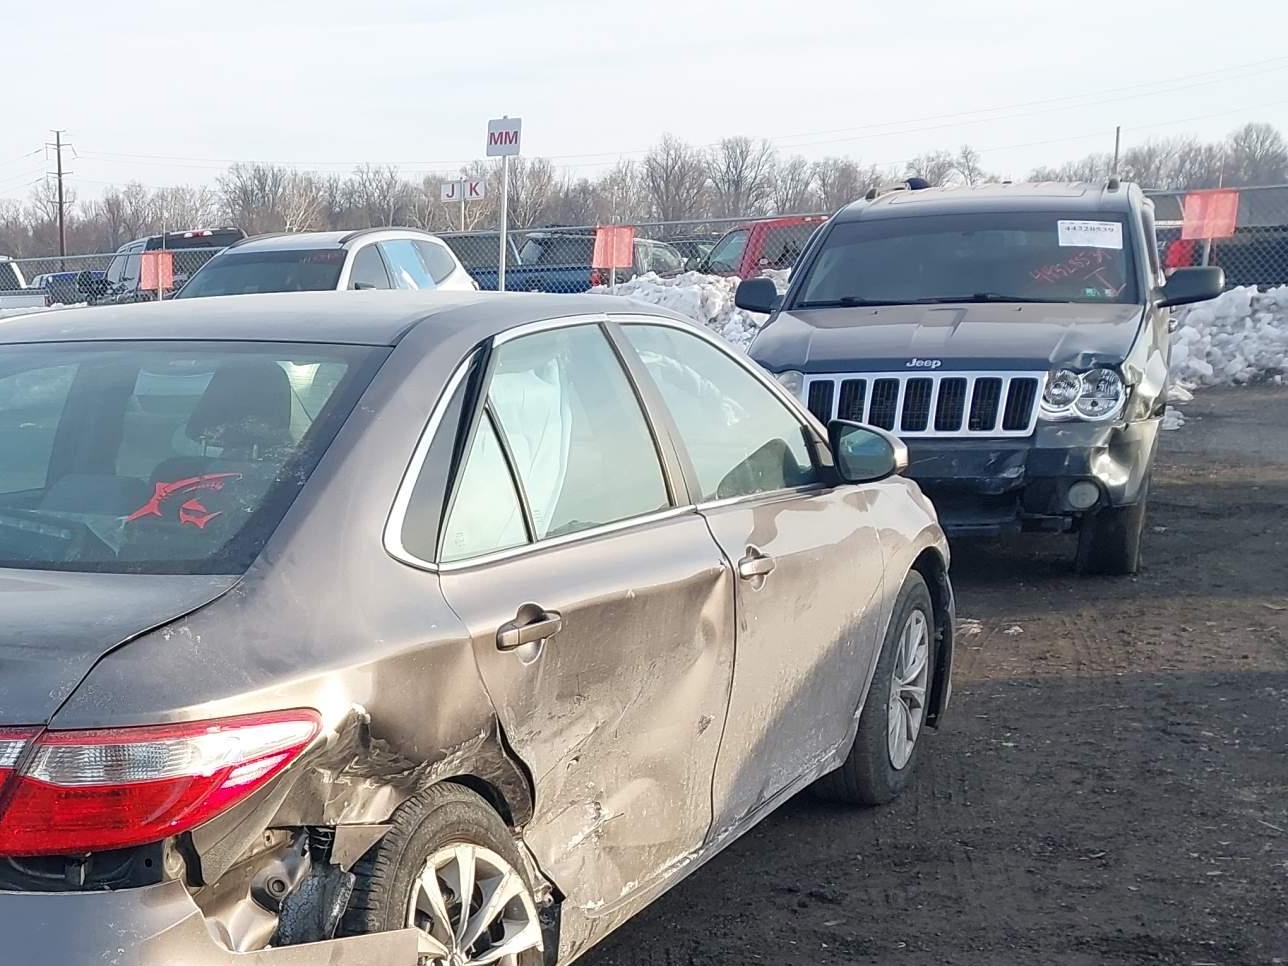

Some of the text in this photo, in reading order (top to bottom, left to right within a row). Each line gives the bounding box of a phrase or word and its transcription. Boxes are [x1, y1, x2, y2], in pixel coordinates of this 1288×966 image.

[489, 130, 518, 145] MM
[446, 182, 480, 198] J K
[905, 358, 942, 369] Jeep
